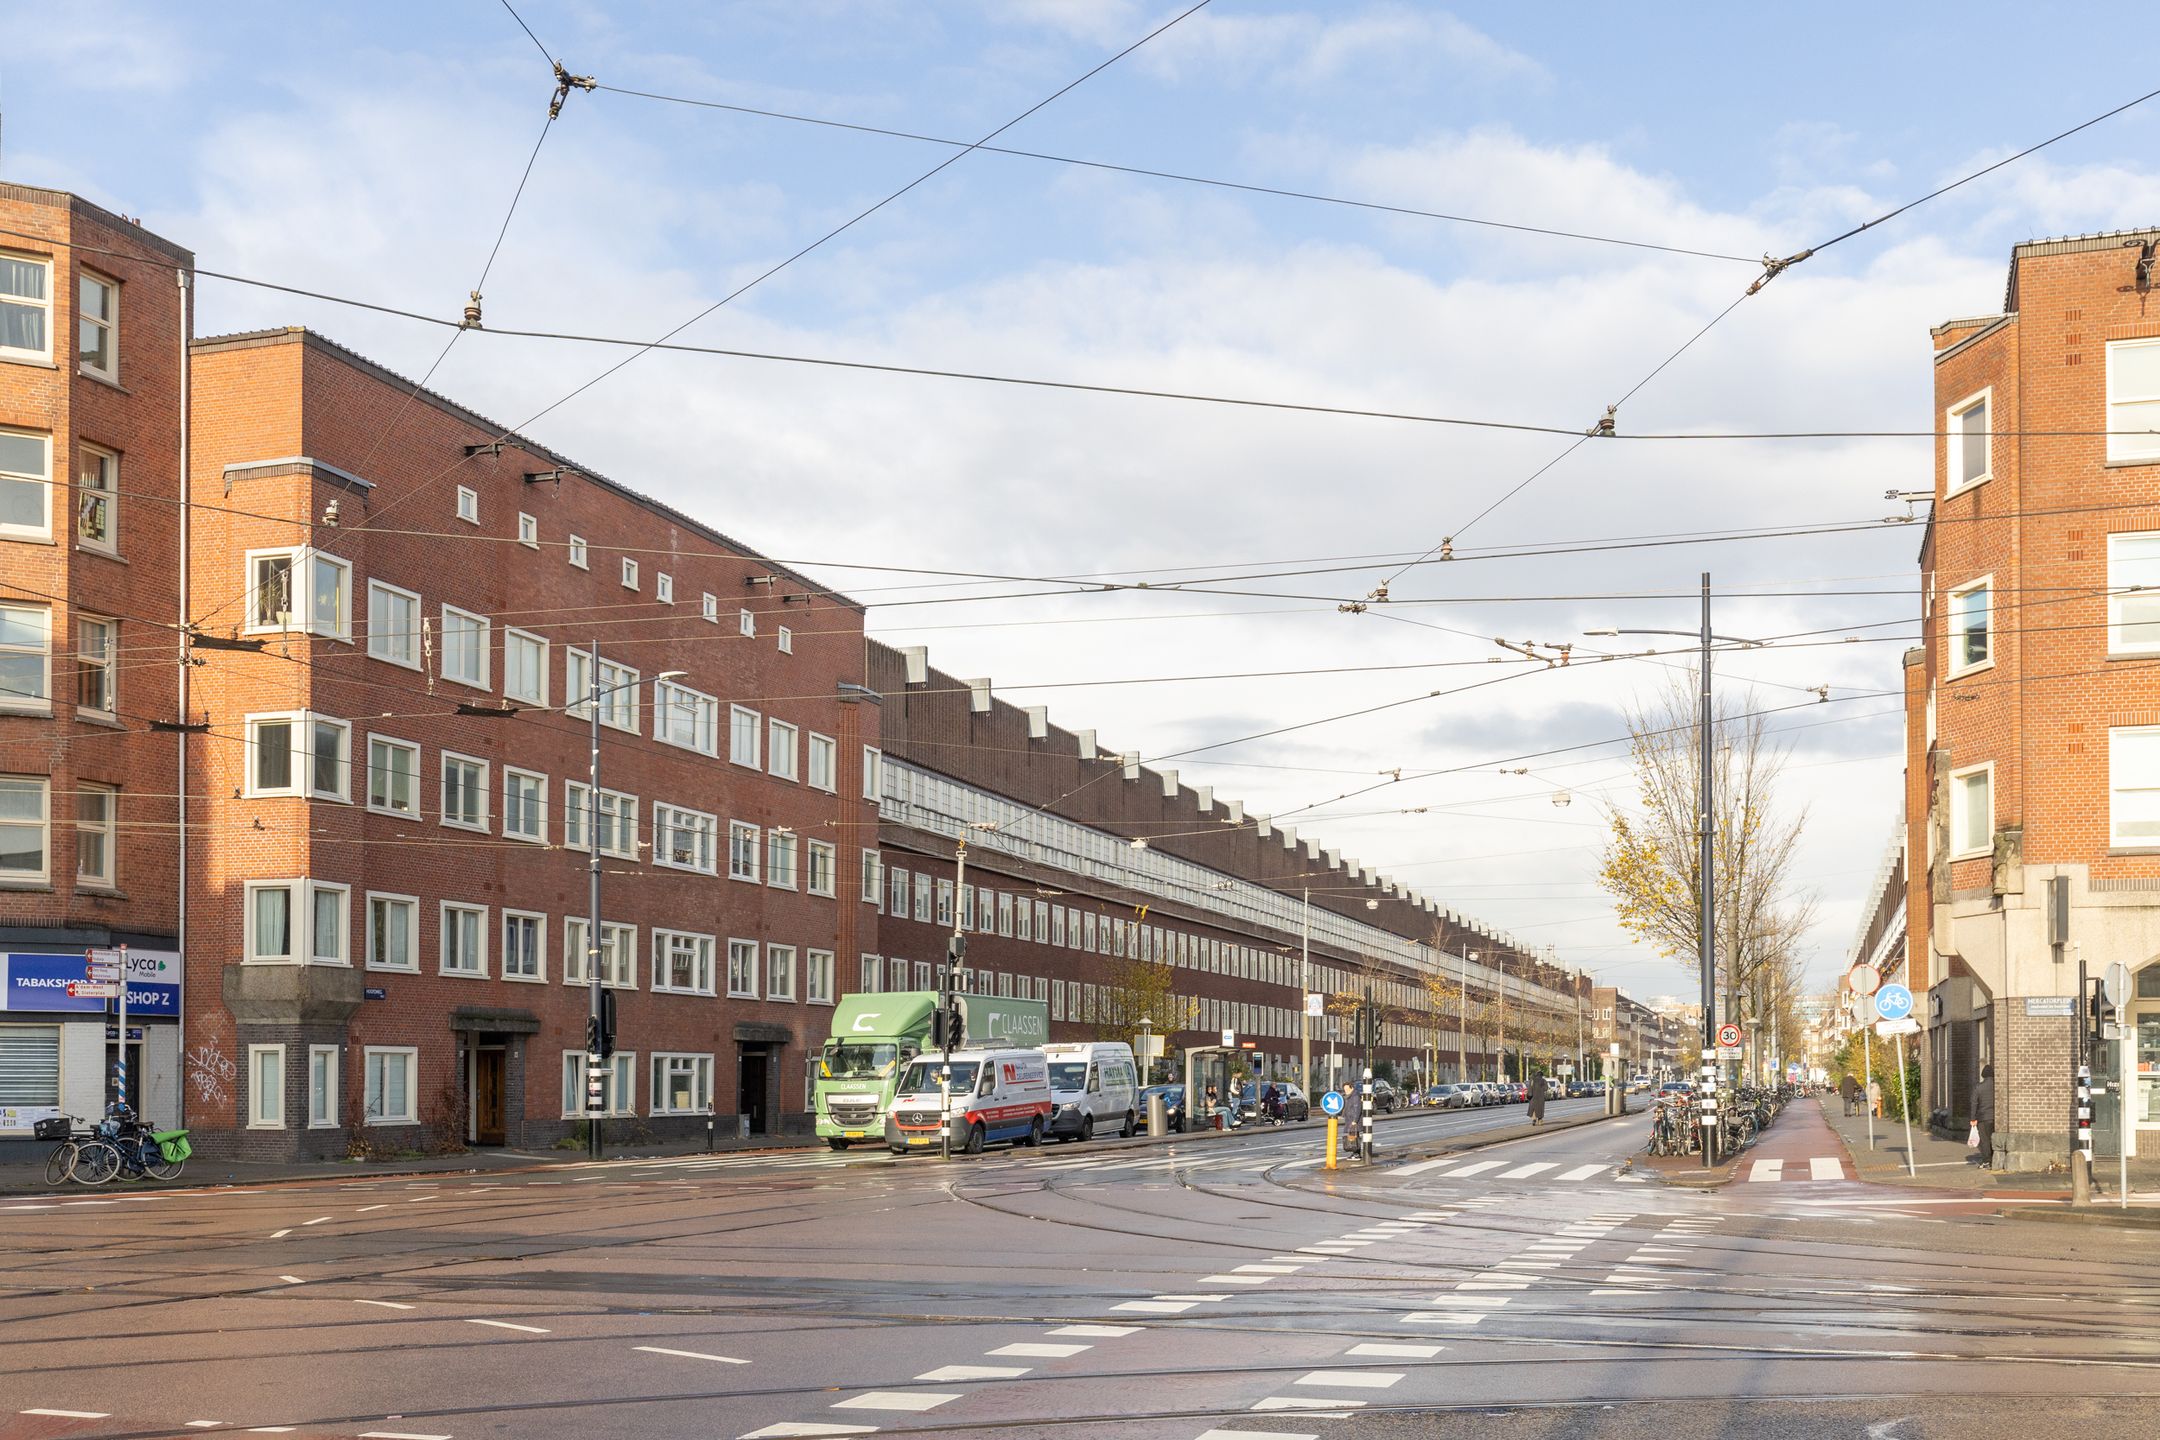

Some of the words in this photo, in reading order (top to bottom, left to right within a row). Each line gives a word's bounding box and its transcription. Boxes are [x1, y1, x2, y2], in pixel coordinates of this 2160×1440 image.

[127, 991, 160, 1005] SHOP
[162, 993, 170, 1006] Z
[1002, 1014, 1043, 1036] CLAASSEN
[1722, 1031, 1737, 1040] 30
